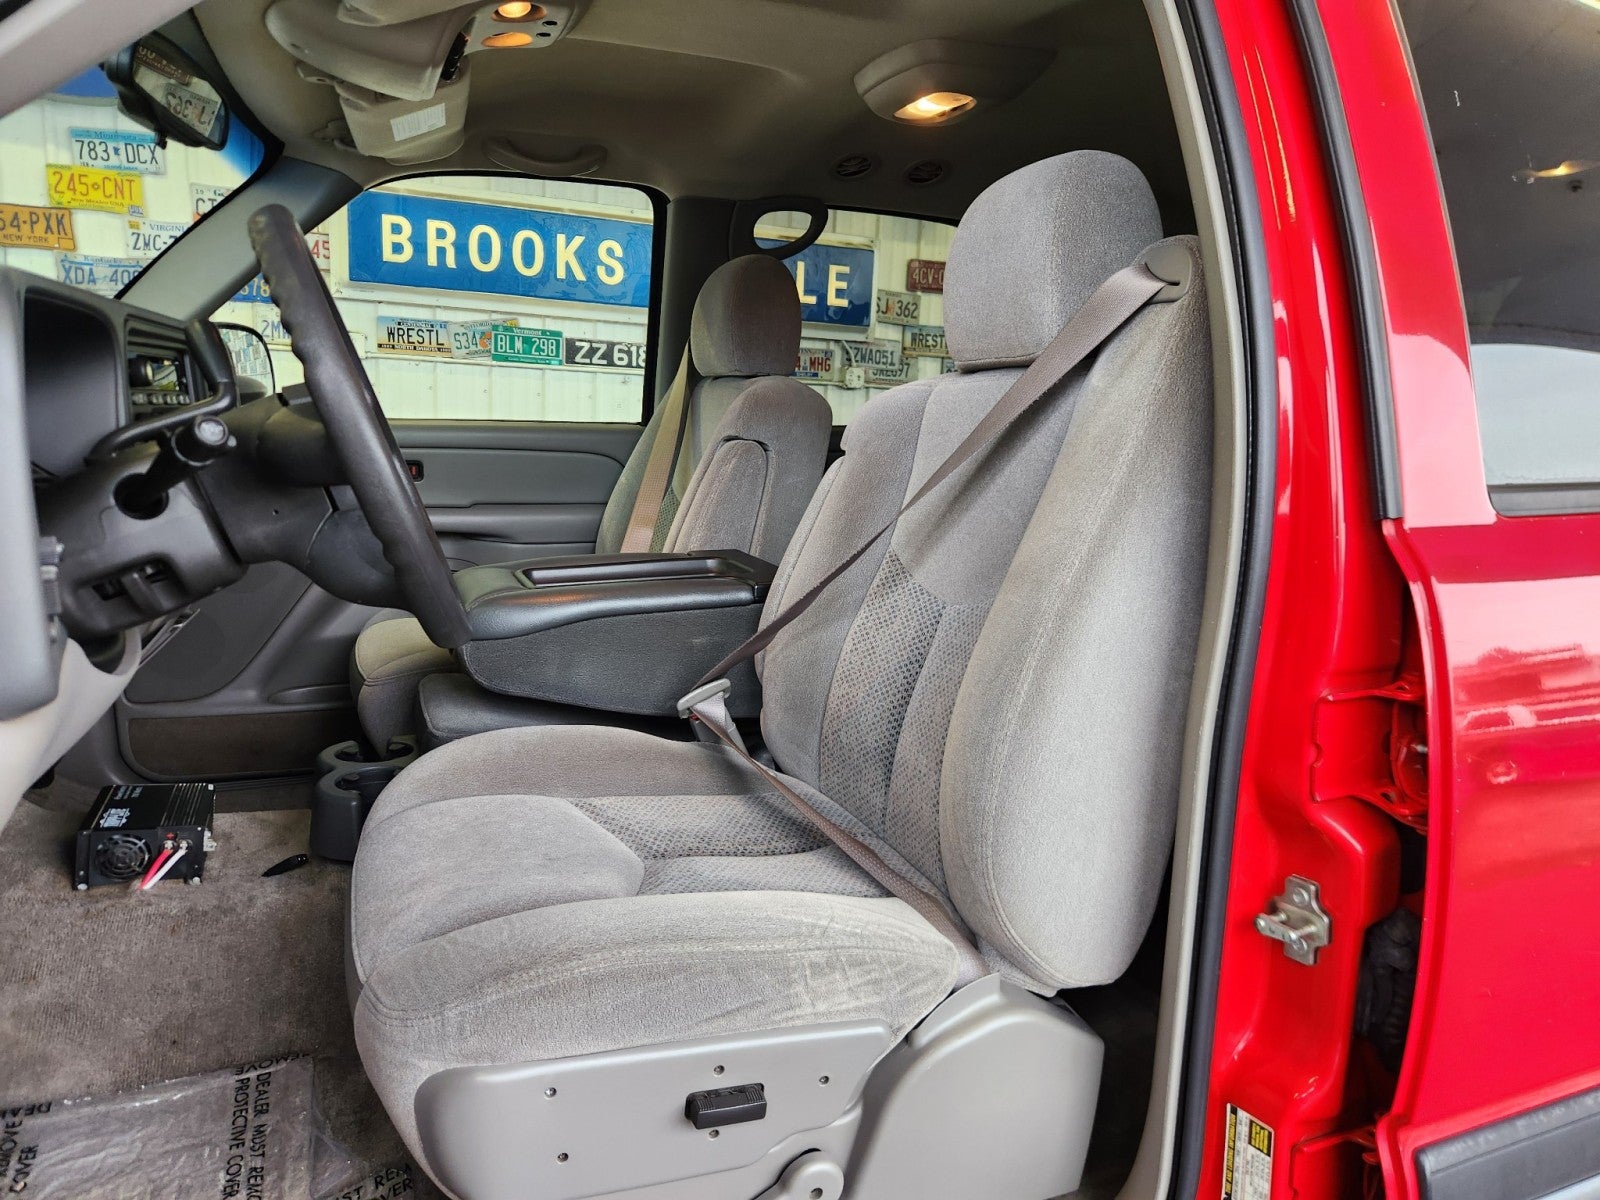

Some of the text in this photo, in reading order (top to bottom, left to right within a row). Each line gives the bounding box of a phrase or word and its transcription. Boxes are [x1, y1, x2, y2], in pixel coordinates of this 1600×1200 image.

[75, 140, 159, 165] 783 DCX
[53, 171, 136, 201] 245 CNT
[3, 234, 49, 244] NEW YORK
[381, 213, 625, 286] BROOKS
[61, 264, 97, 285] XDA
[796, 260, 850, 308] LE
[896, 299, 918, 319] 362
[387, 326, 445, 347] WRESTL
[454, 330, 478, 350] S34
[513, 328, 542, 336] Vermont
[497, 334, 557, 357] BLM 298
[574, 341, 608, 365] ZZ
[809, 356, 832, 372] MHG
[253, 1072, 271, 1118] DEALER
[222, 1077, 251, 1200] PROTECTIVE COVER
[250, 1123, 267, 1158] MUST
